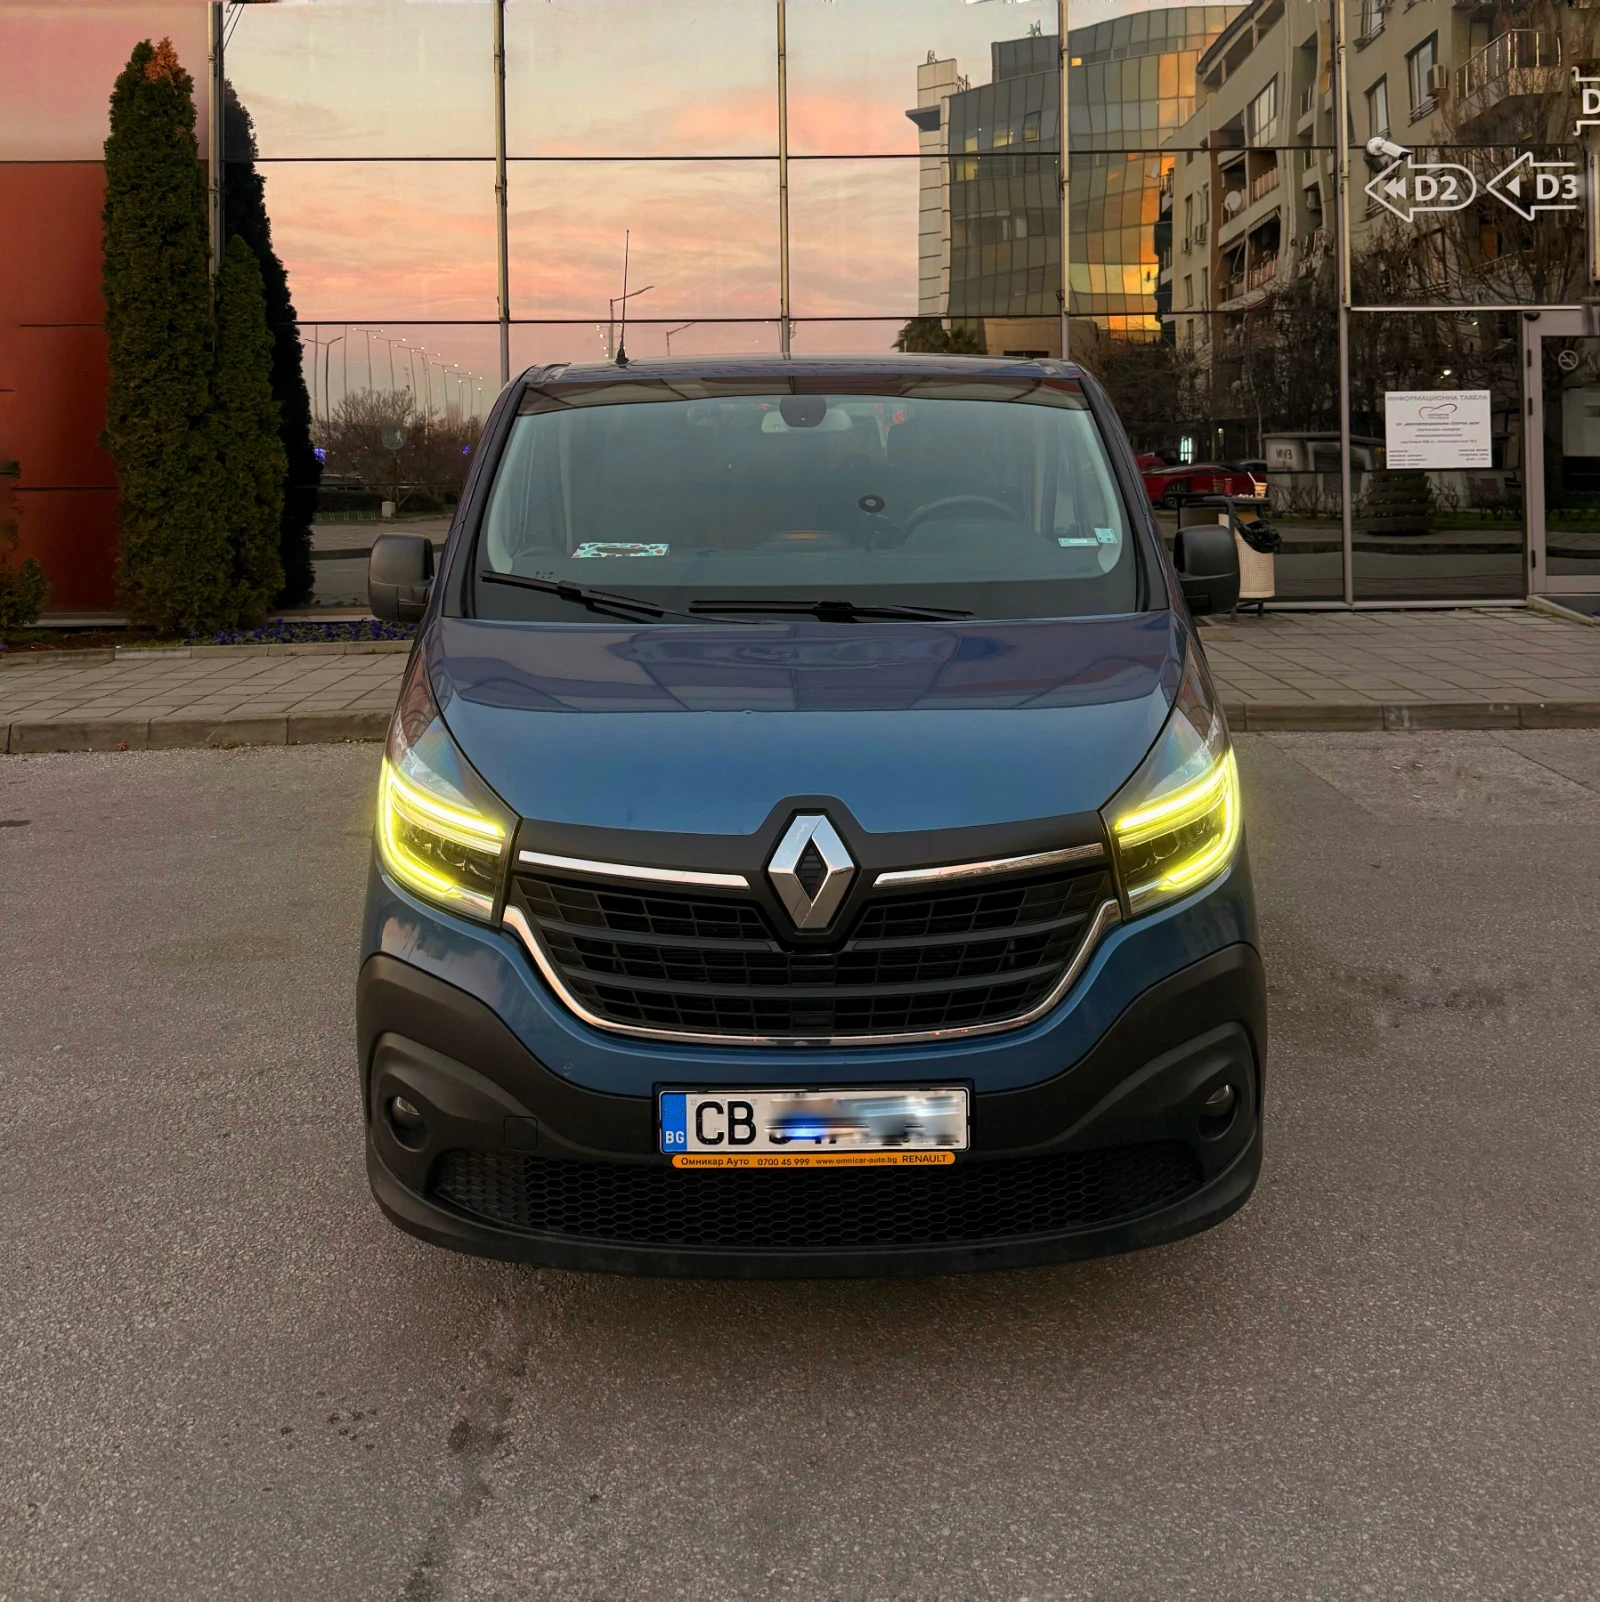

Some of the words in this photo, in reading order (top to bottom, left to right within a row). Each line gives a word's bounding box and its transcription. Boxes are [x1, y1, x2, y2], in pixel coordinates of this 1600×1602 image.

[1415, 175, 1459, 201] D2
[1536, 173, 1577, 200] D3
[665, 1130, 685, 1144] BG
[681, 1157, 723, 1167] Омникар
[726, 1157, 750, 1167] Ауто
[757, 1158, 779, 1166] 0700
[781, 1158, 792, 1166] 45
[793, 1157, 811, 1166] 999
[816, 1156, 898, 1165] www.omnicar-auto.bg
[902, 1154, 947, 1163] RENAULT
